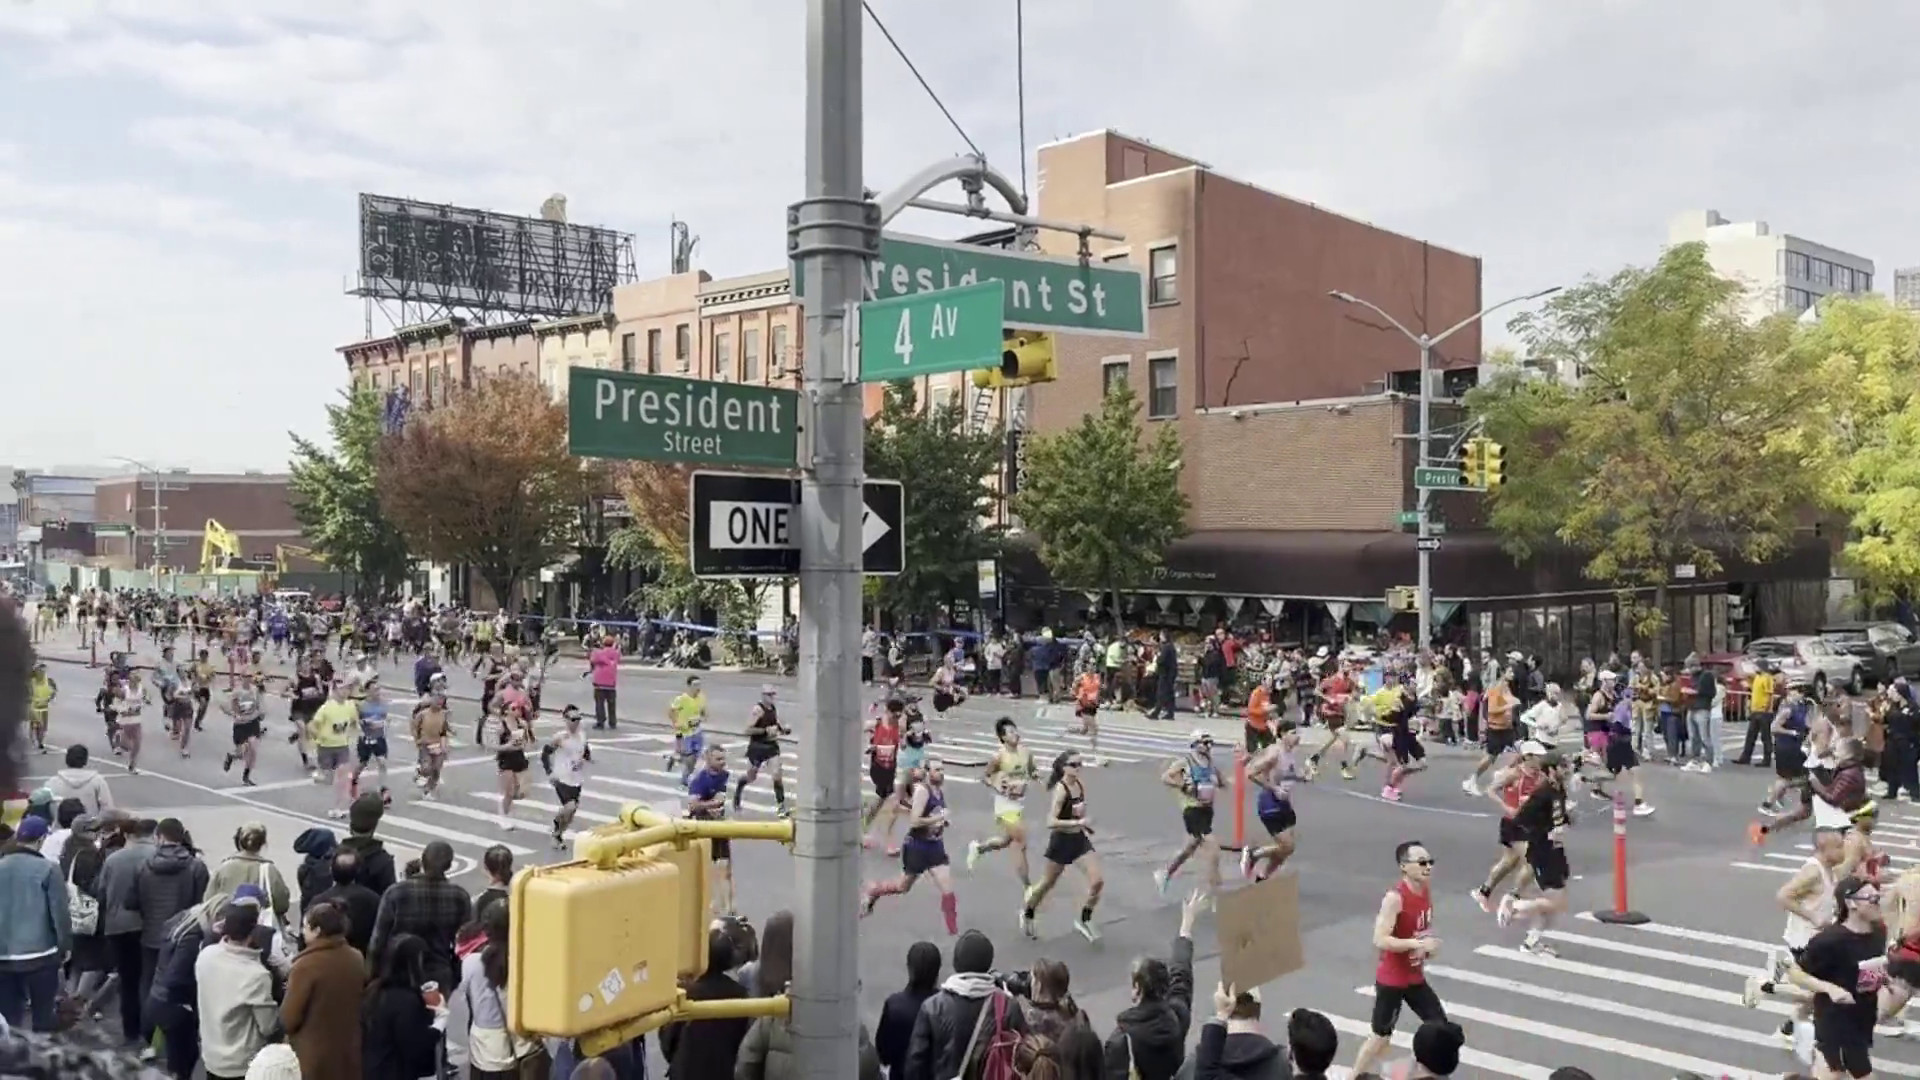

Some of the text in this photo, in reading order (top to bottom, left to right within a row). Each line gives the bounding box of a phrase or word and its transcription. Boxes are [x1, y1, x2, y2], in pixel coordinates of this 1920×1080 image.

[870, 260, 1106, 317] residnt St
[894, 308, 914, 365] 4
[595, 378, 782, 433] President
[663, 430, 723, 455] Street
[728, 506, 789, 544] ONE
